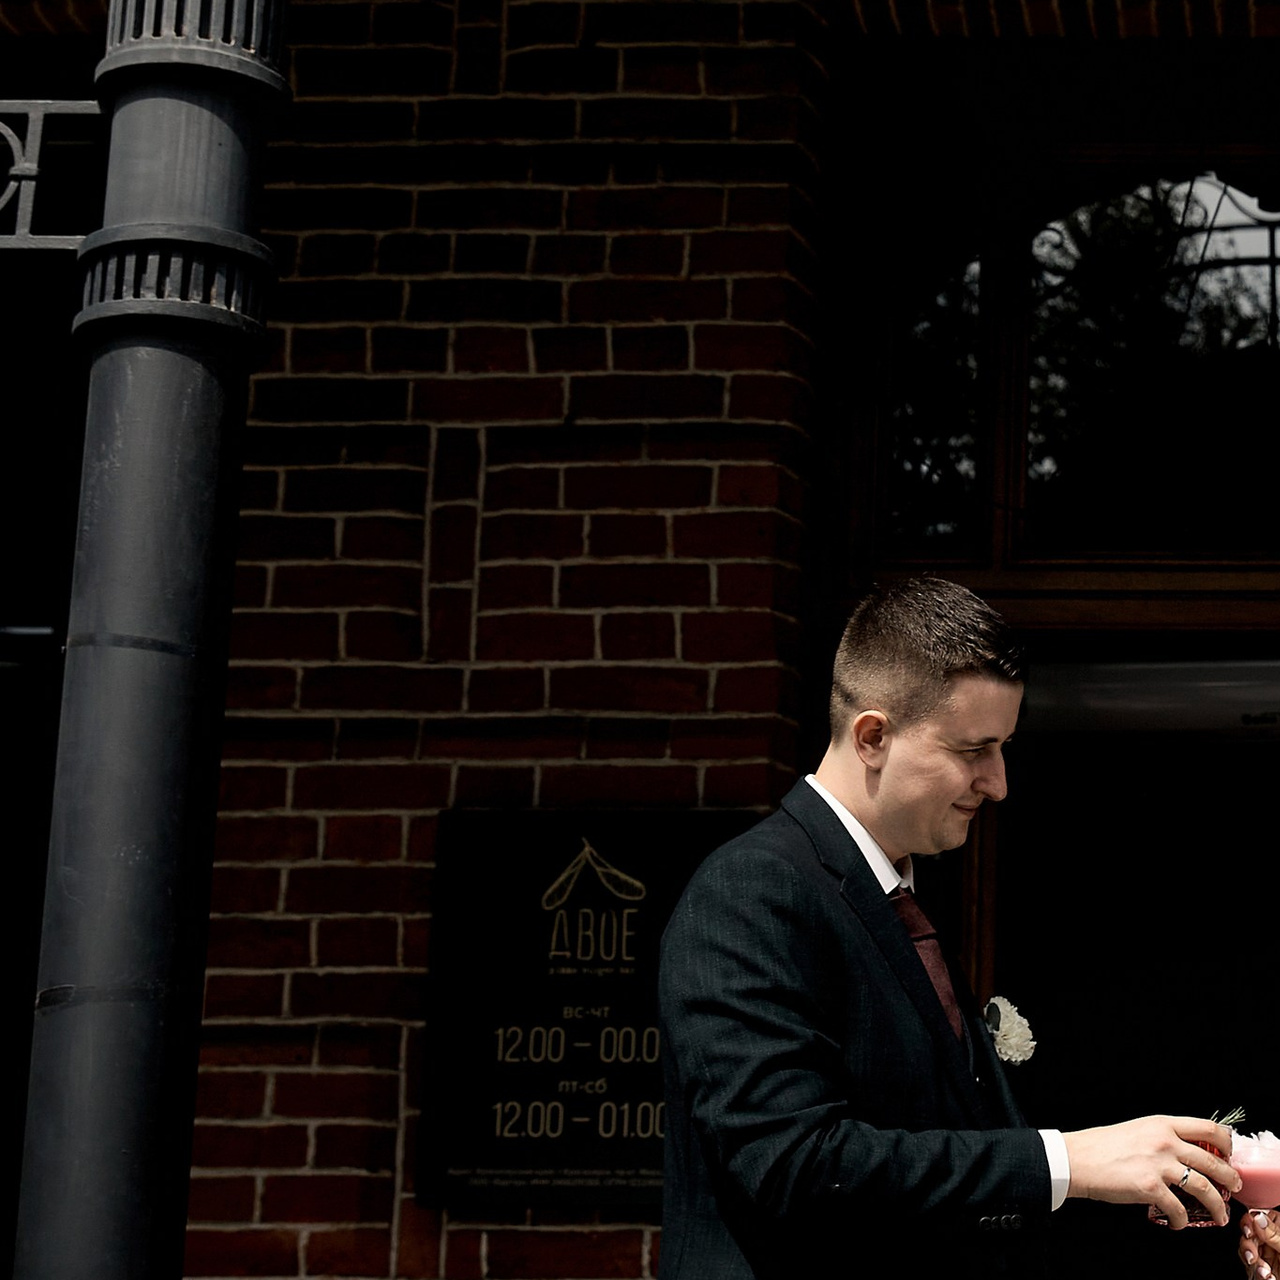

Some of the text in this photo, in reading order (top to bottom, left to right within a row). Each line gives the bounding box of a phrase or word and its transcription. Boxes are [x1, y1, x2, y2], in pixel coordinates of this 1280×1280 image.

[549, 908, 639, 961] ДВОЕ
[494, 1026, 566, 1063] 12.00
[600, 1026, 661, 1063] 00.0
[492, 1101, 565, 1138] 12.00
